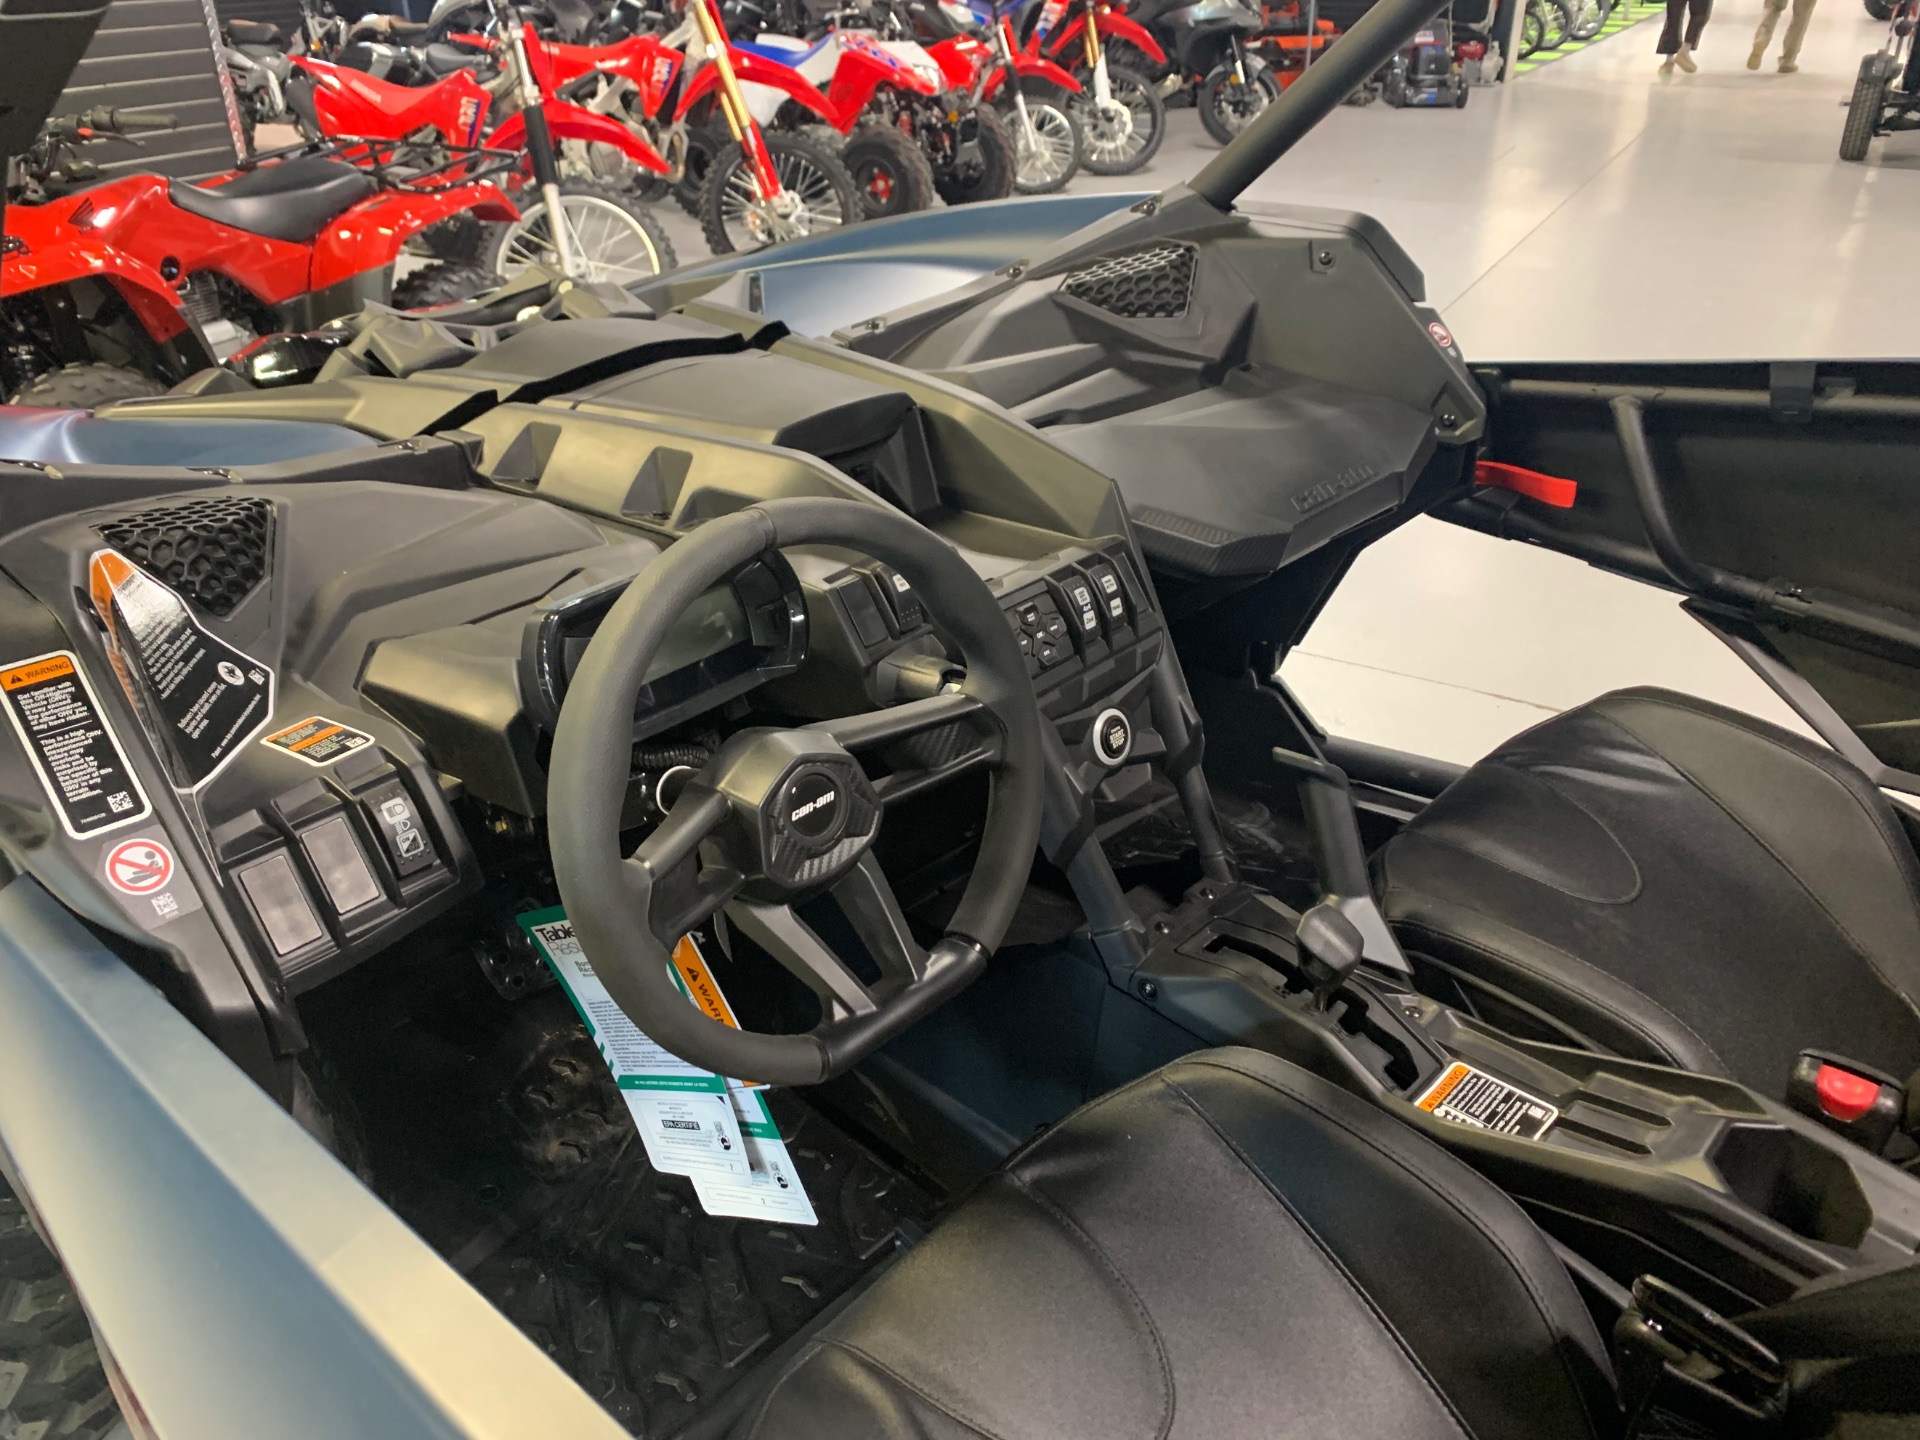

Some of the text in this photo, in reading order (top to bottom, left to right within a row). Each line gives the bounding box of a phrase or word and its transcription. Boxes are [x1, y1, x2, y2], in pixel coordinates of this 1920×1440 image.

[25, 661, 70, 680] WARNING
[791, 790, 835, 822] can-am
[1430, 1069, 1464, 1103] WARNING
